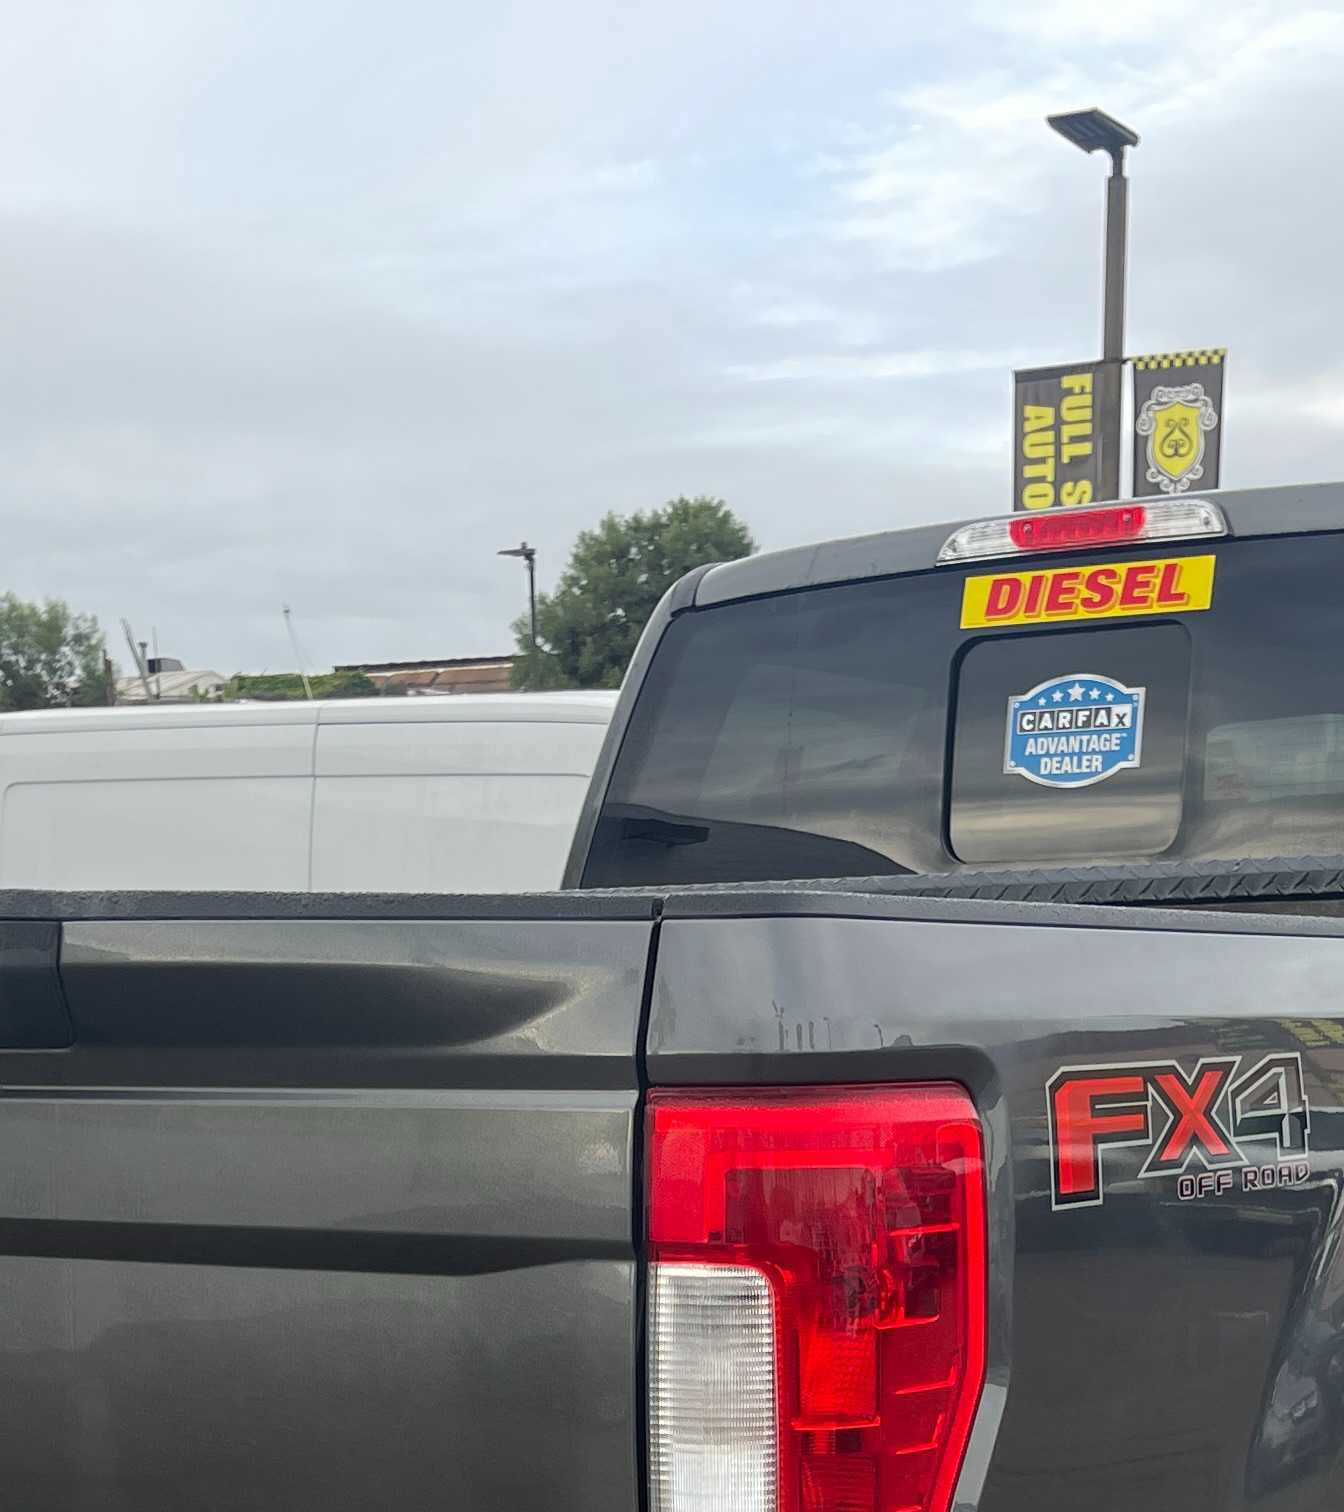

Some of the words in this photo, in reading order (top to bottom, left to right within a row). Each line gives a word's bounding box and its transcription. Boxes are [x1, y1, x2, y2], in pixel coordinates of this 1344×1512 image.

[1060, 373, 1093, 464] FULL
[1023, 404, 1055, 510] AUTO
[984, 562, 1188, 621] DIESEL
[1021, 709, 1128, 731] CARFAX
[1025, 733, 1121, 756] ADVANTAGE
[1040, 755, 1103, 775] DEALER
[1047, 1054, 1308, 1209] FX4
[1177, 1169, 1233, 1200] OFF
[1242, 1161, 1311, 1192] ROAD
